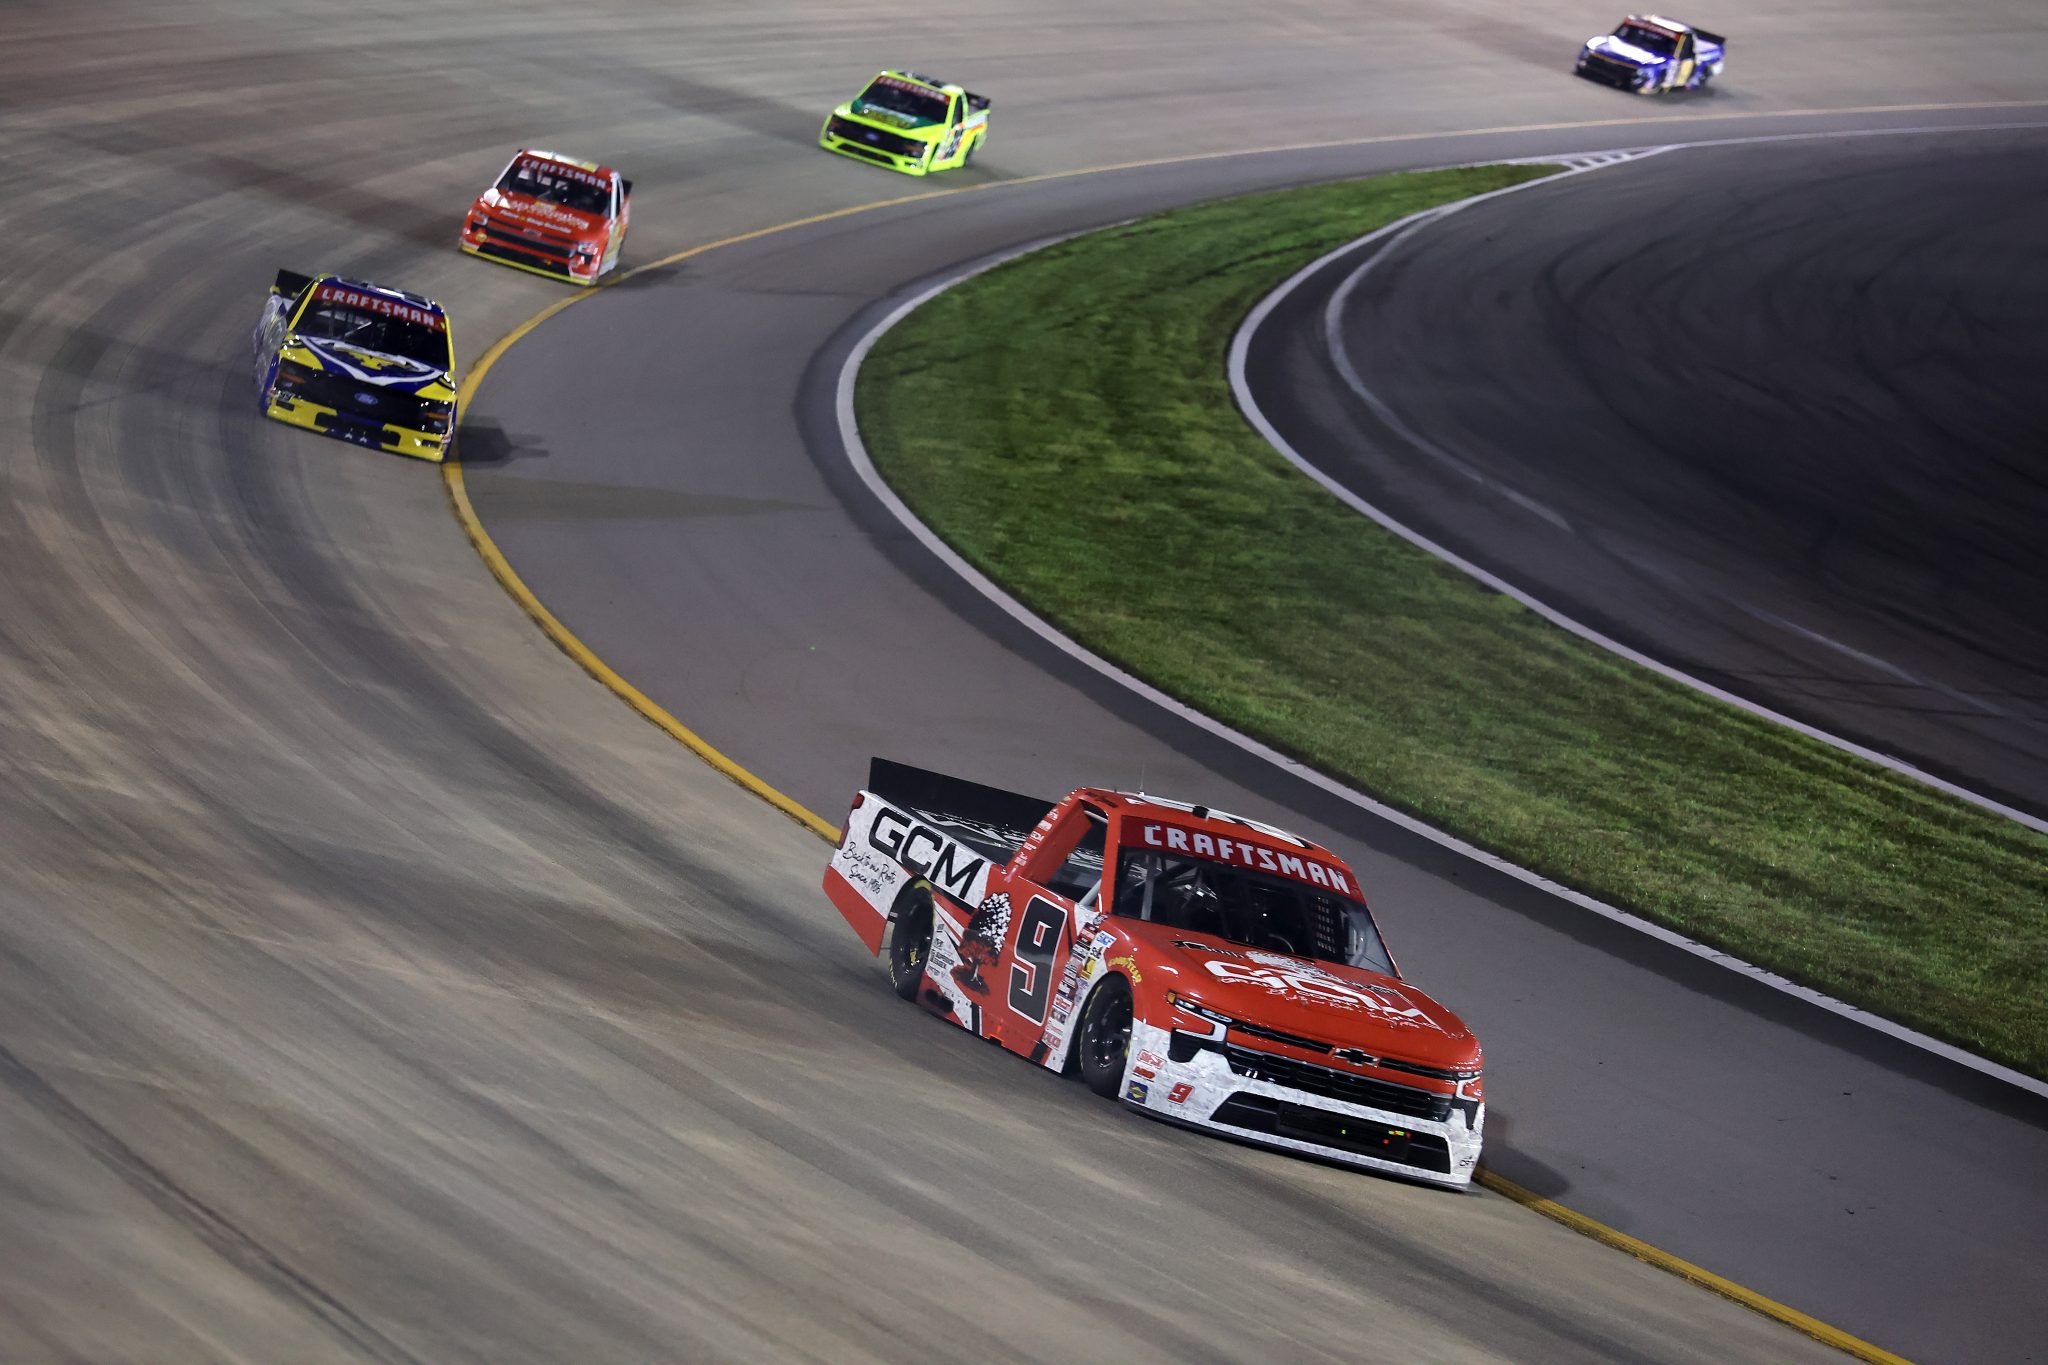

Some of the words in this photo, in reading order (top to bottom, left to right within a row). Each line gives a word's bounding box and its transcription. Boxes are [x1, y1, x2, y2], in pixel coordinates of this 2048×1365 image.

[521, 158, 607, 190] CRAFTSMAN
[321, 287, 436, 327] CRAFTSMAN
[868, 806, 986, 901] GCM
[1144, 824, 1351, 895] CRAFTSMAN
[1007, 893, 1068, 1027] 9
[1167, 1081, 1196, 1105] 9
